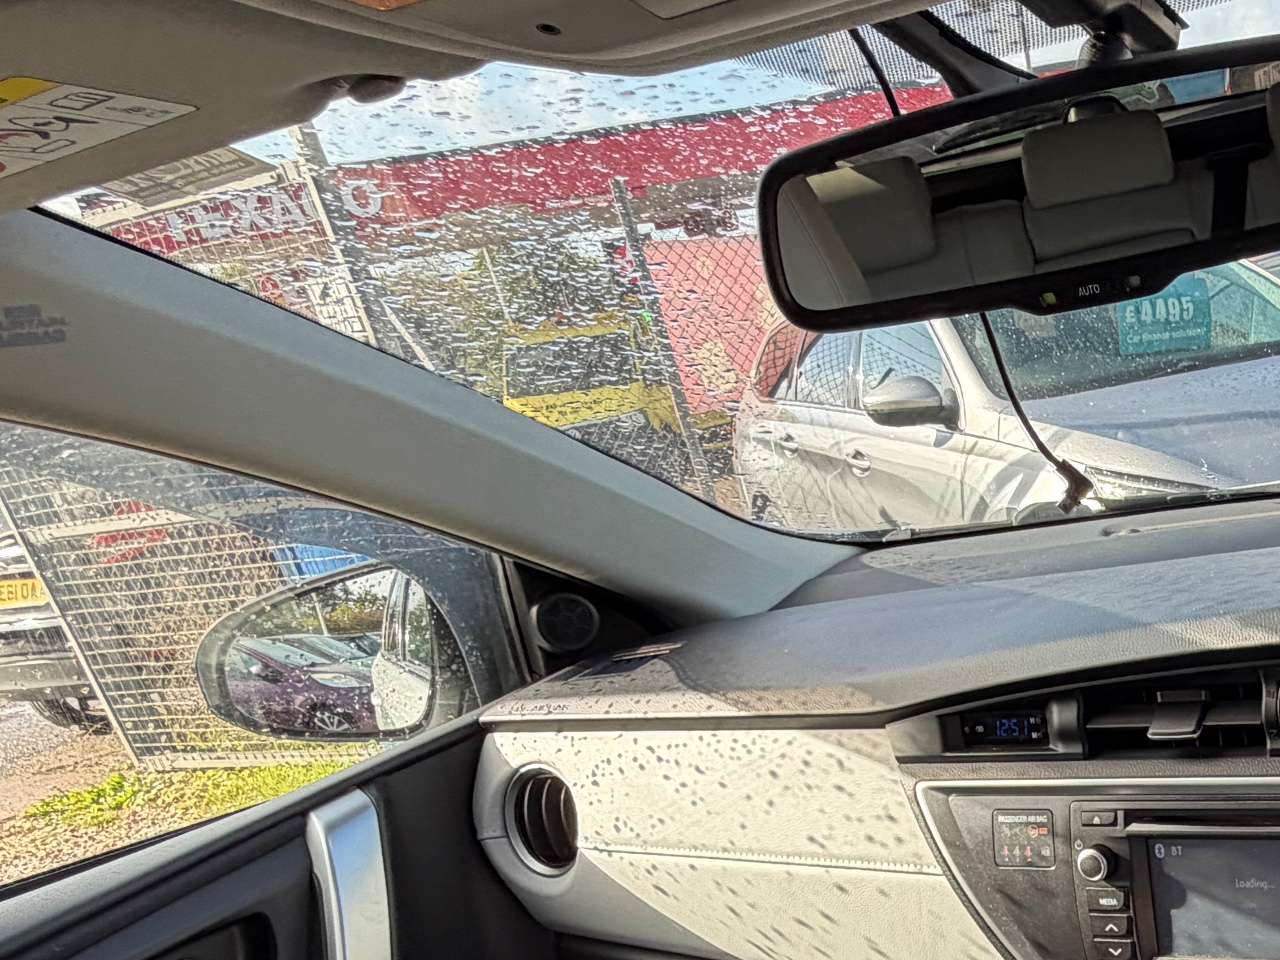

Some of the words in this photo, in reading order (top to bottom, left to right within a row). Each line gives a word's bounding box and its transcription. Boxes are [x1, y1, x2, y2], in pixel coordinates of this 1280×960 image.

[1078, 283, 1100, 297] AUTO
[1125, 296, 1194, 323] £4495
[1170, 846, 1183, 857] BT
[1099, 898, 1119, 906] MEDIA
